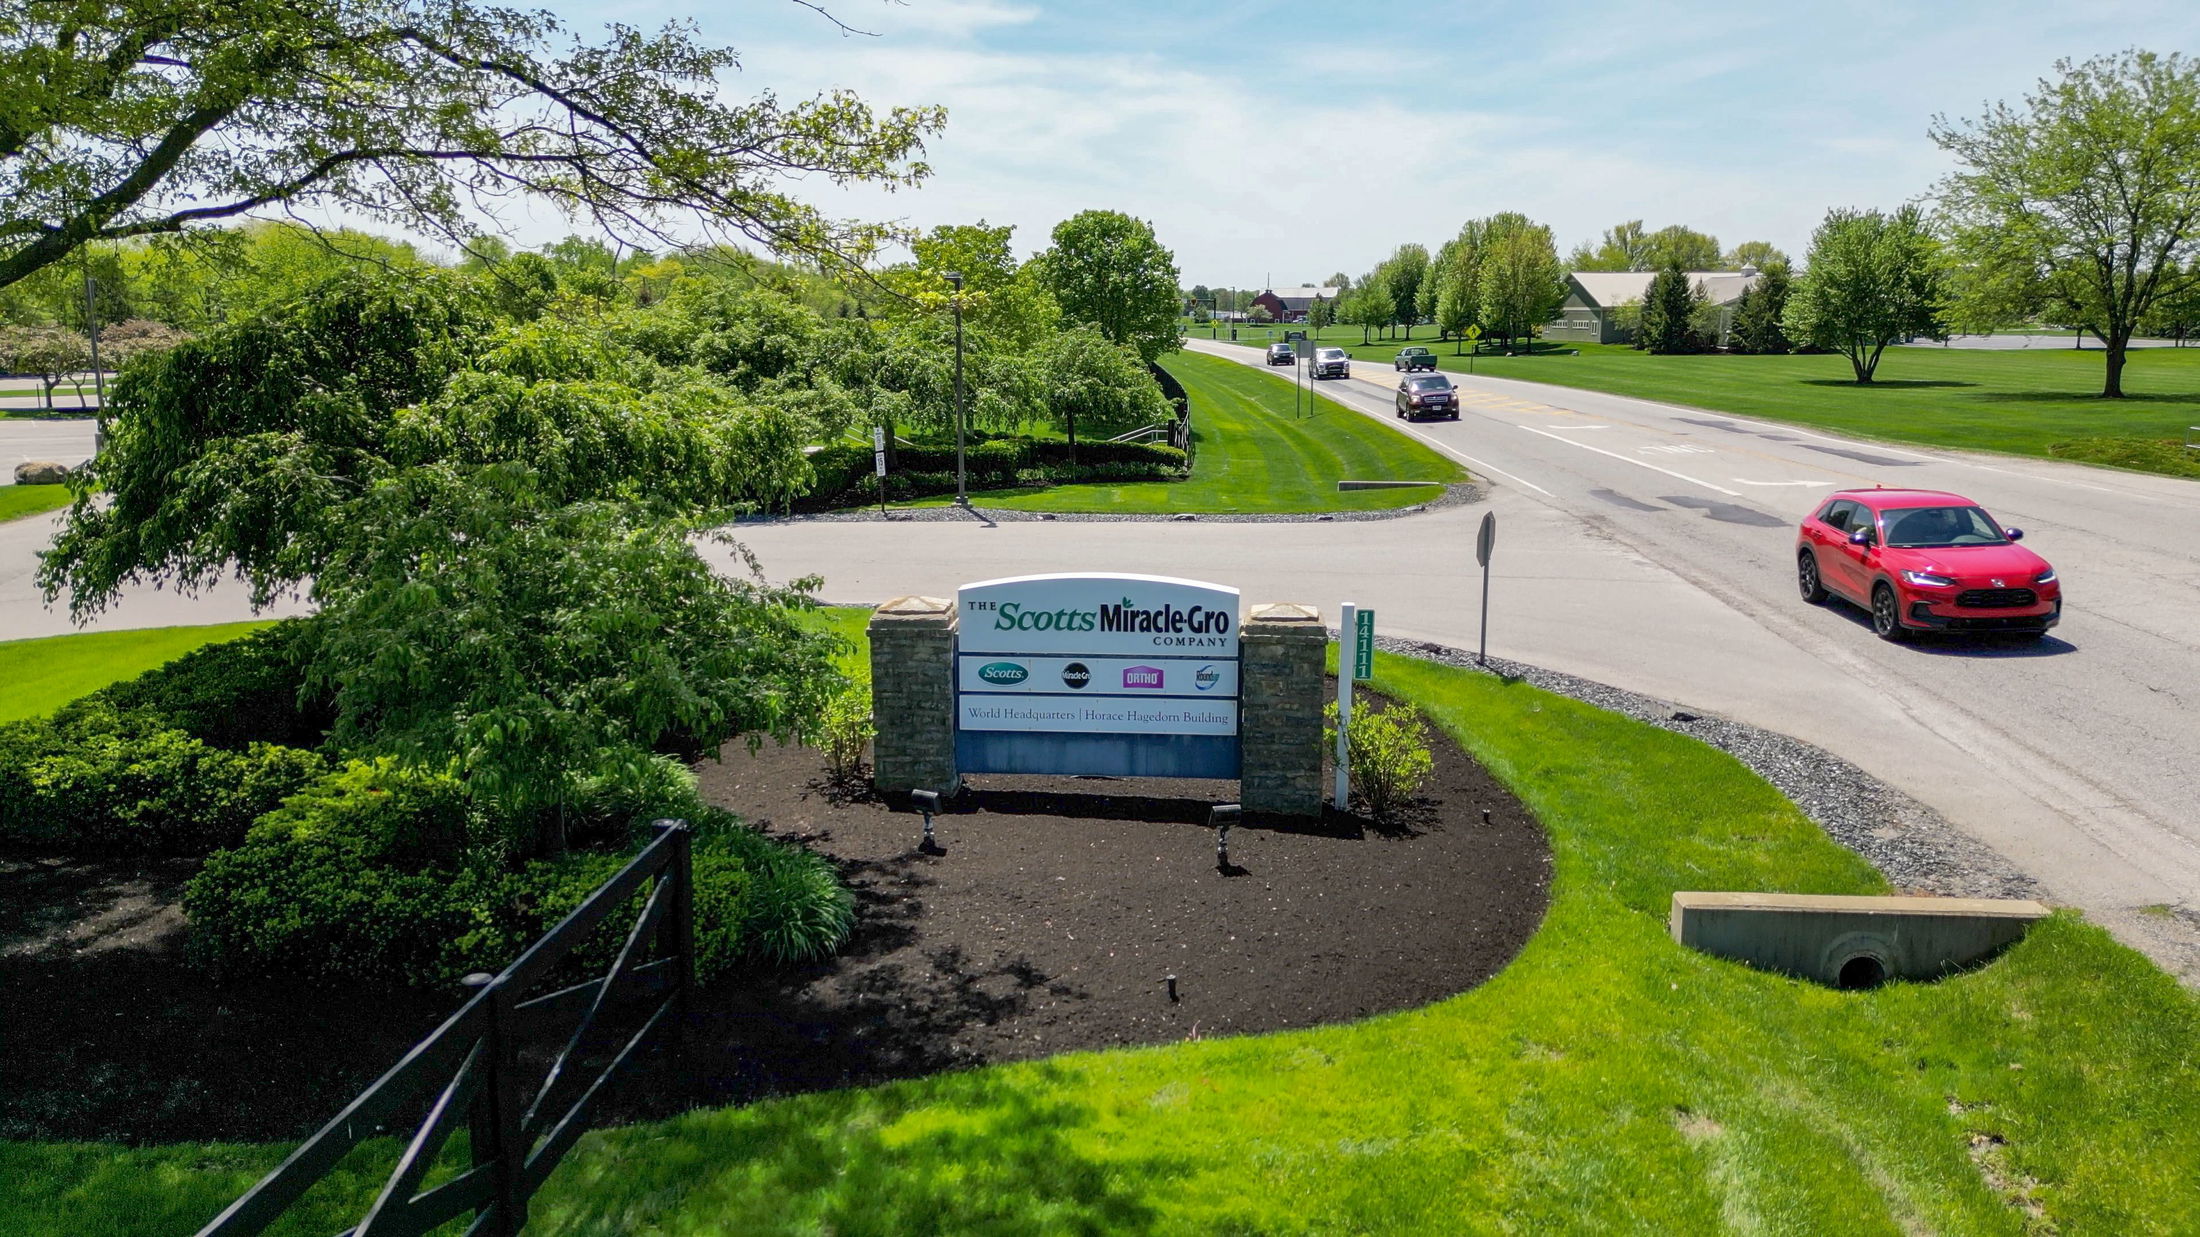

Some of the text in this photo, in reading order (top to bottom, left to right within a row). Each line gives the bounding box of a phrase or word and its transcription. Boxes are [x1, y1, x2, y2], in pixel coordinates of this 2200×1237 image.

[968, 601, 997, 611] THE
[994, 602, 1097, 632] Scotts
[1153, 636, 1227, 647] COMPANY
[1358, 611, 1371, 678] 14111
[984, 666, 1024, 679] Scotts
[1127, 672, 1158, 685] ORTHO
[968, 707, 1229, 725] World Headquarters Horace Hagedorn Building
